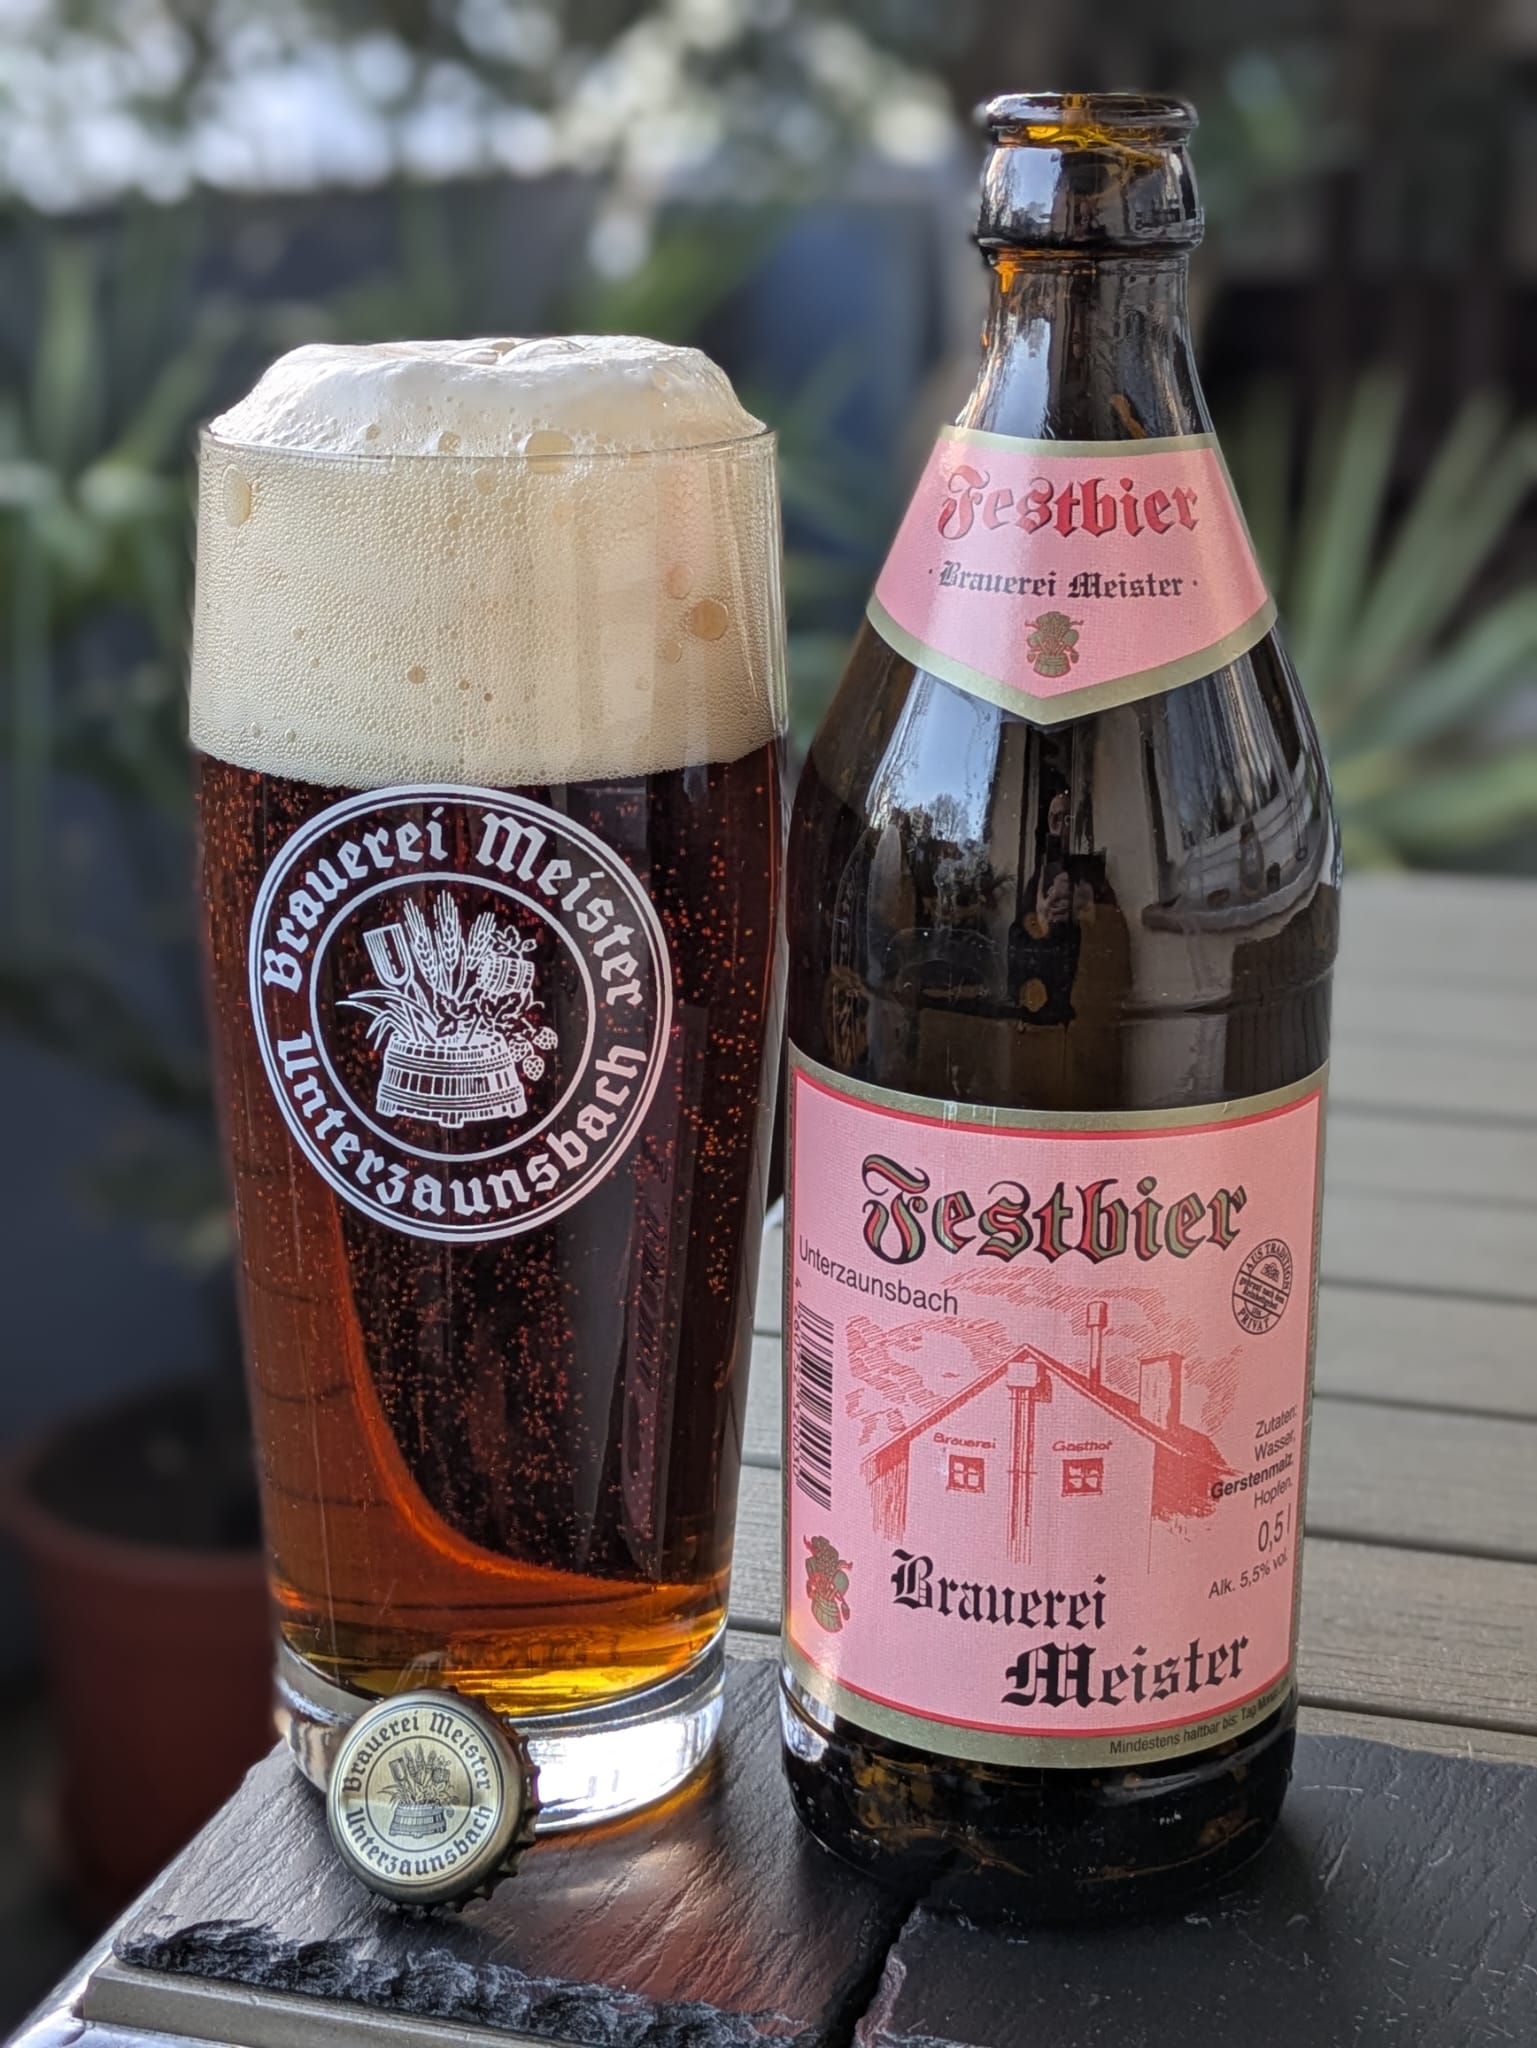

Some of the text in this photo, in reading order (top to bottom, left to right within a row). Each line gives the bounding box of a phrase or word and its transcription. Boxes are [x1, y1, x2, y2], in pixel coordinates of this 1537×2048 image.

[937, 464, 1198, 540] Festbier
[939, 561, 1184, 599] Brauerei Meister
[263, 806, 644, 1007] Brauerei Meister
[277, 1030, 648, 1217] Unterzaunsbach
[861, 1154, 1247, 1264] Festbier
[799, 1234, 959, 1315] Unterzaunsbach
[1237, 1307, 1270, 1331] PRIVAT
[933, 1432, 1114, 1451] Brauerei Gasthof
[1258, 1510, 1284, 1553] 0,5
[891, 1548, 1107, 1630] Brauerei
[1239, 1560, 1270, 1588] 5,5%
[1001, 1634, 1248, 1709] Meister
[342, 1711, 492, 1793] Brauerei Meister
[1110, 1733, 1181, 1755] Mindestens
[1183, 1721, 1220, 1743] haltbar
[345, 1805, 494, 1877] Unterzaunsbach
